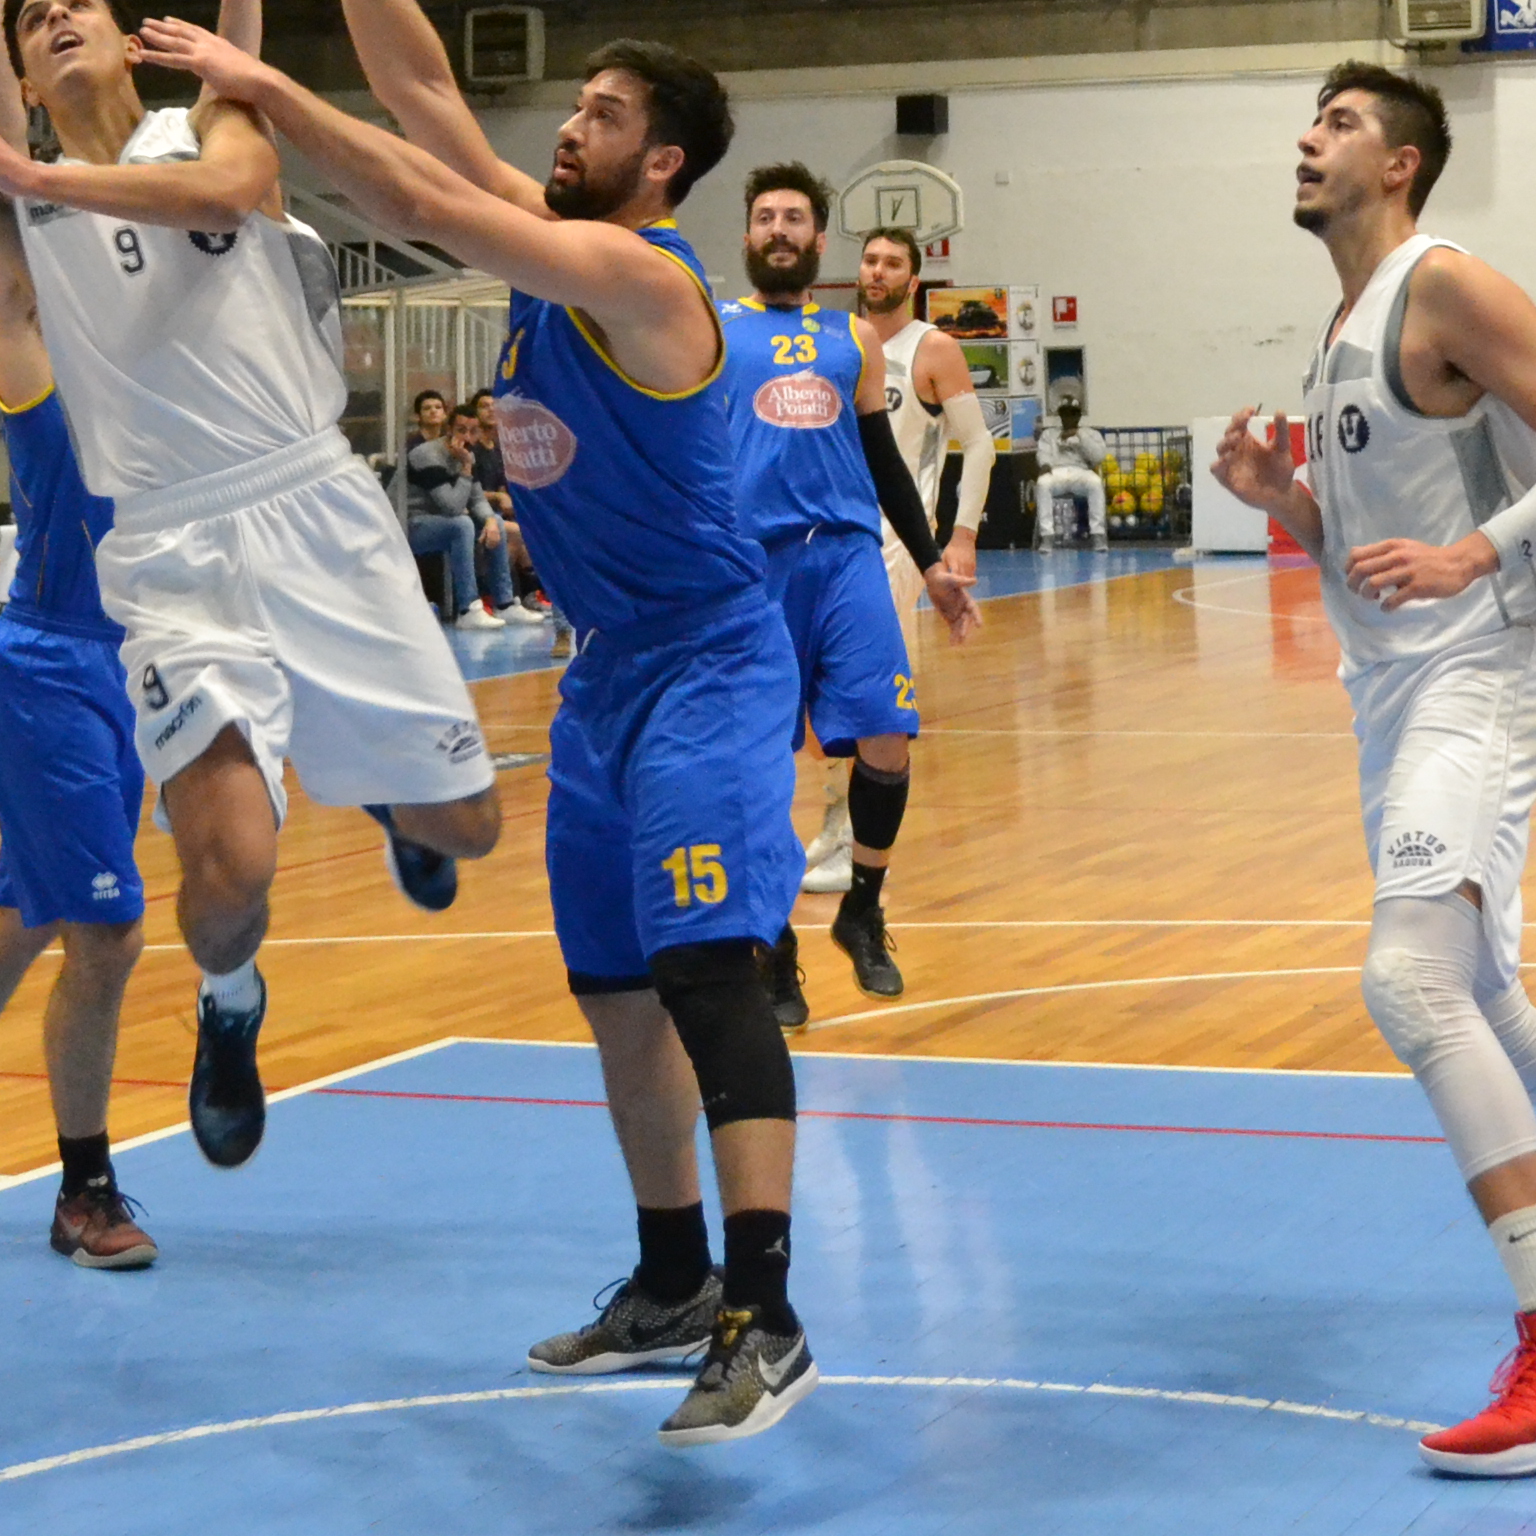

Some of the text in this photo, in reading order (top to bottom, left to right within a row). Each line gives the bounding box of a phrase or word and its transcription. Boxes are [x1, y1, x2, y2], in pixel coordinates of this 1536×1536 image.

[114, 225, 147, 277] 9
[770, 334, 819, 365] 23
[767, 384, 832, 404] Alberto
[142, 663, 170, 712] 9
[1386, 830, 1447, 856] VIRTUS
[661, 843, 729, 908] 15
